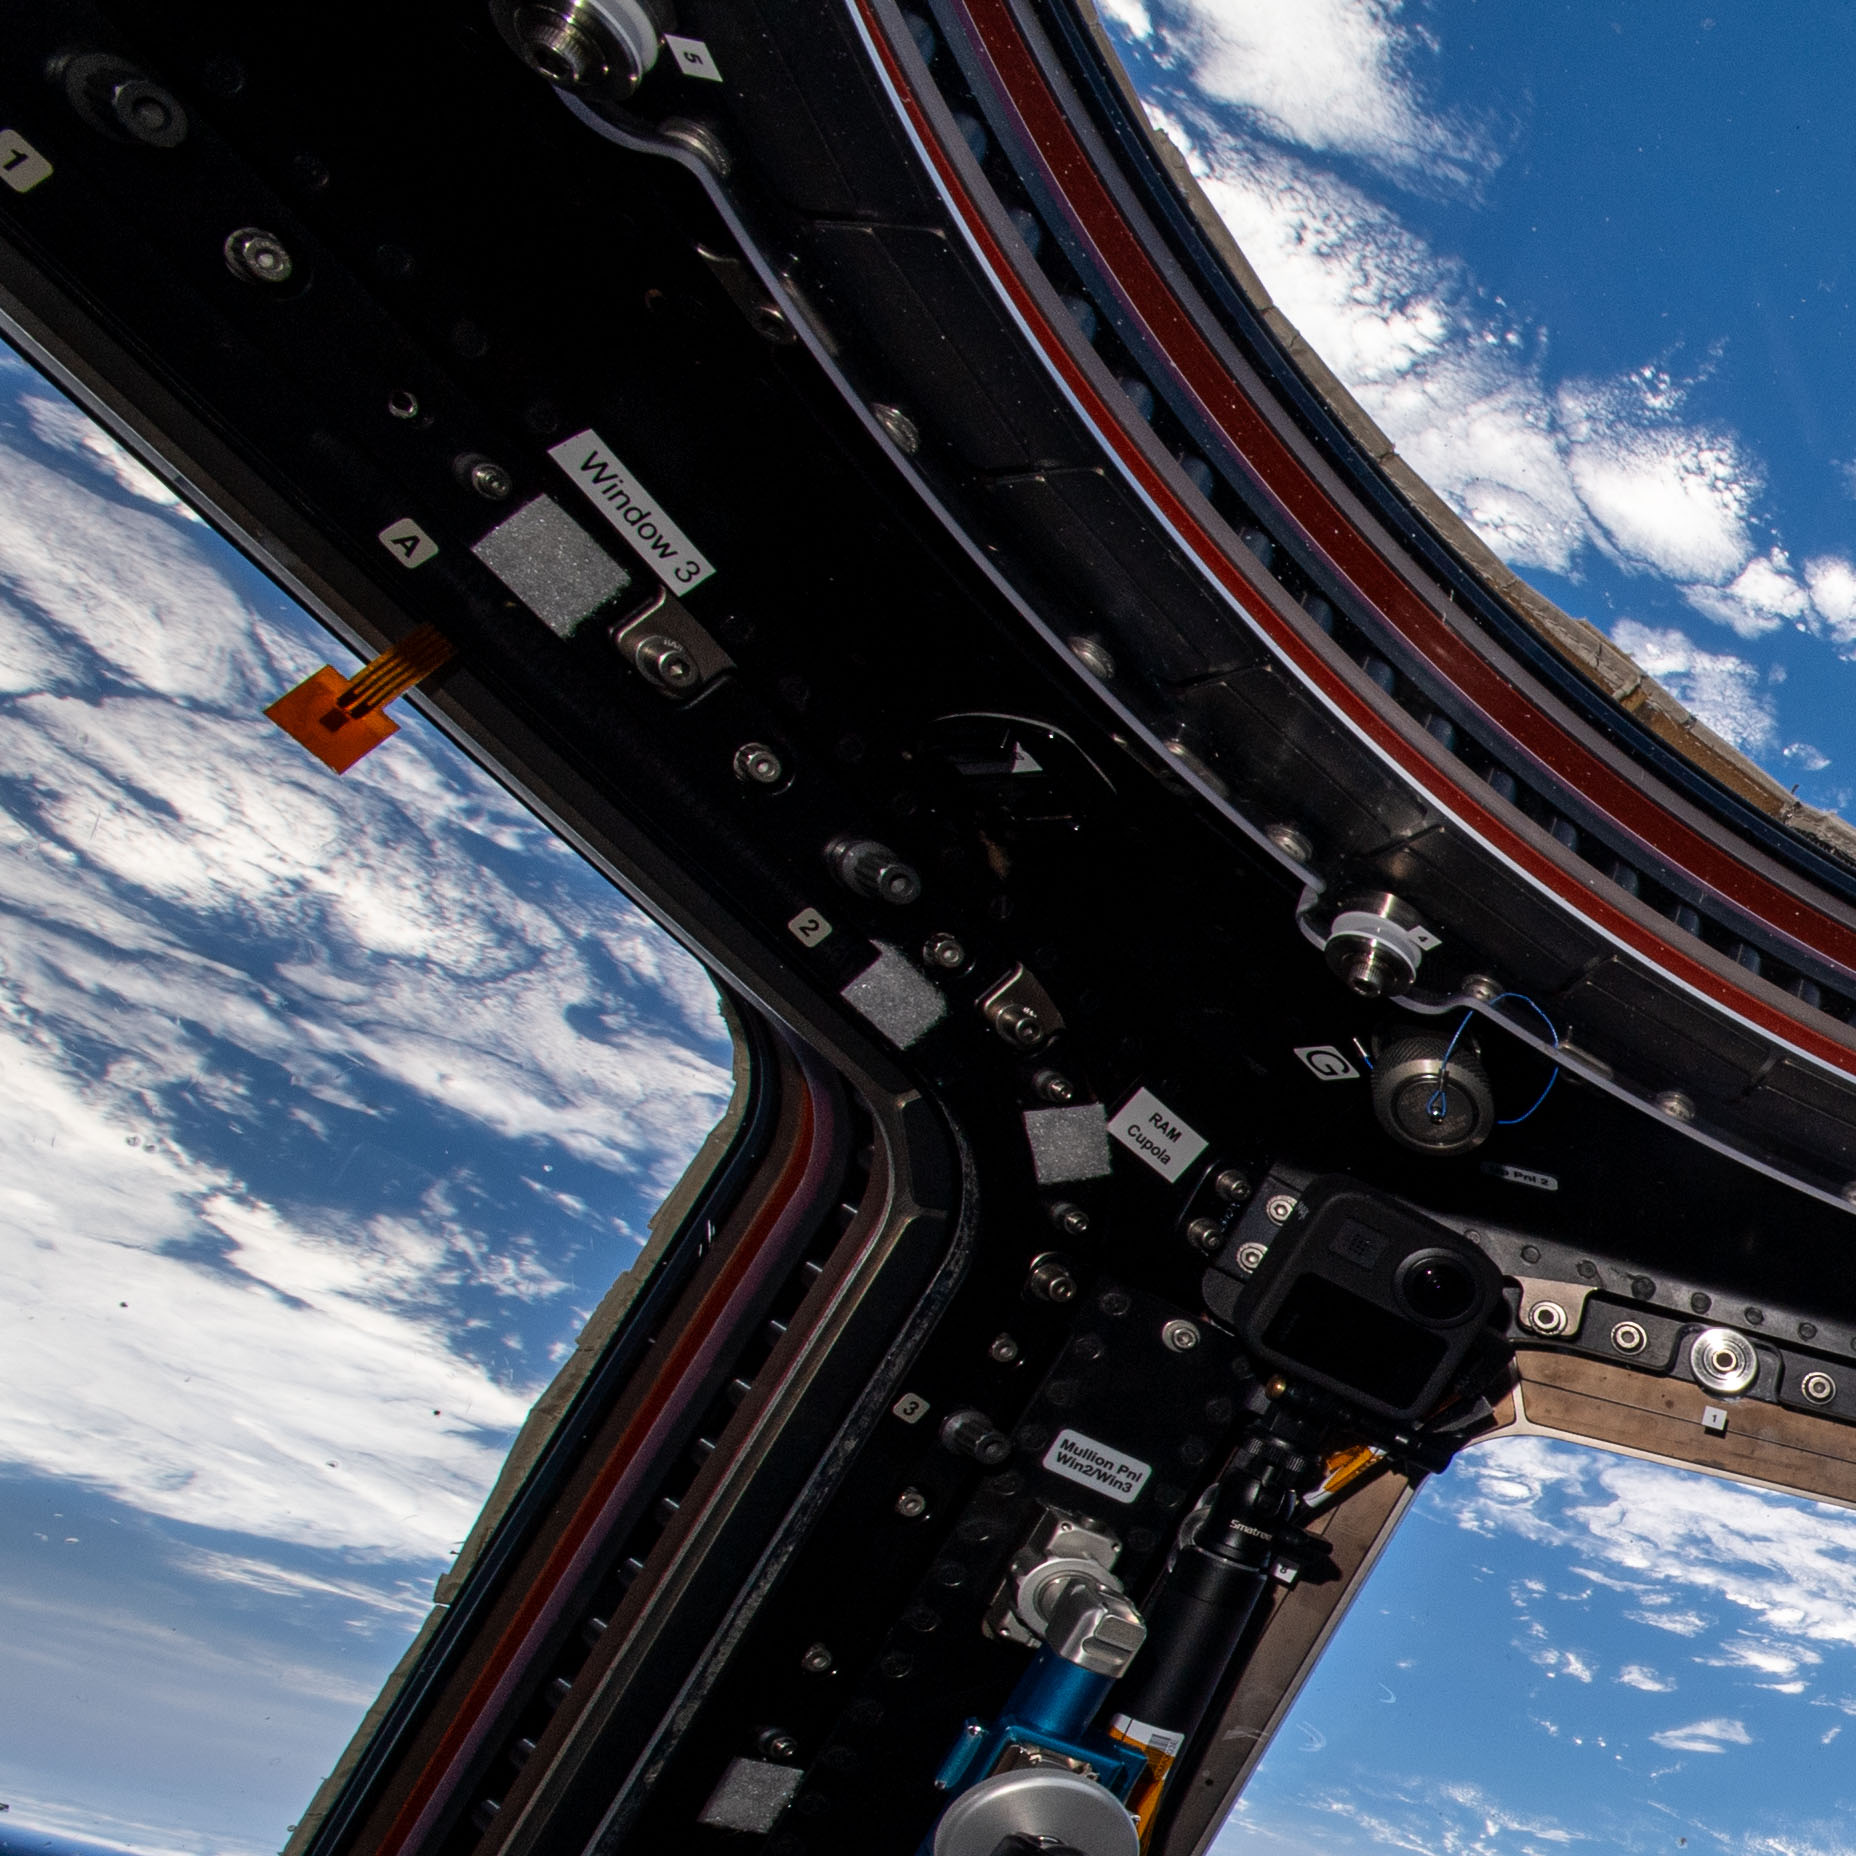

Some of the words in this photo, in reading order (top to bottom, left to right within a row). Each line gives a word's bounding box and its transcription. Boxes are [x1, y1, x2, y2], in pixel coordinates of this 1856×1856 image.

[684, 51, 704, 66] 5
[581, 451, 678, 558] Window
[674, 561, 700, 582] 3
[392, 535, 422, 558] A
[798, 919, 820, 938] 2
[1306, 1050, 1350, 1076] G
[1149, 1113, 1182, 1142] RAM
[1127, 1124, 1172, 1166] Cupola
[1513, 1170, 1538, 1184] Pnl
[903, 1401, 920, 1416] 3
[1056, 1451, 1134, 1494] Win2/Win3
[1060, 1439, 1114, 1472] Mullion
[1117, 1464, 1144, 1482] Pnl
[1229, 1519, 1274, 1542] Smatree
